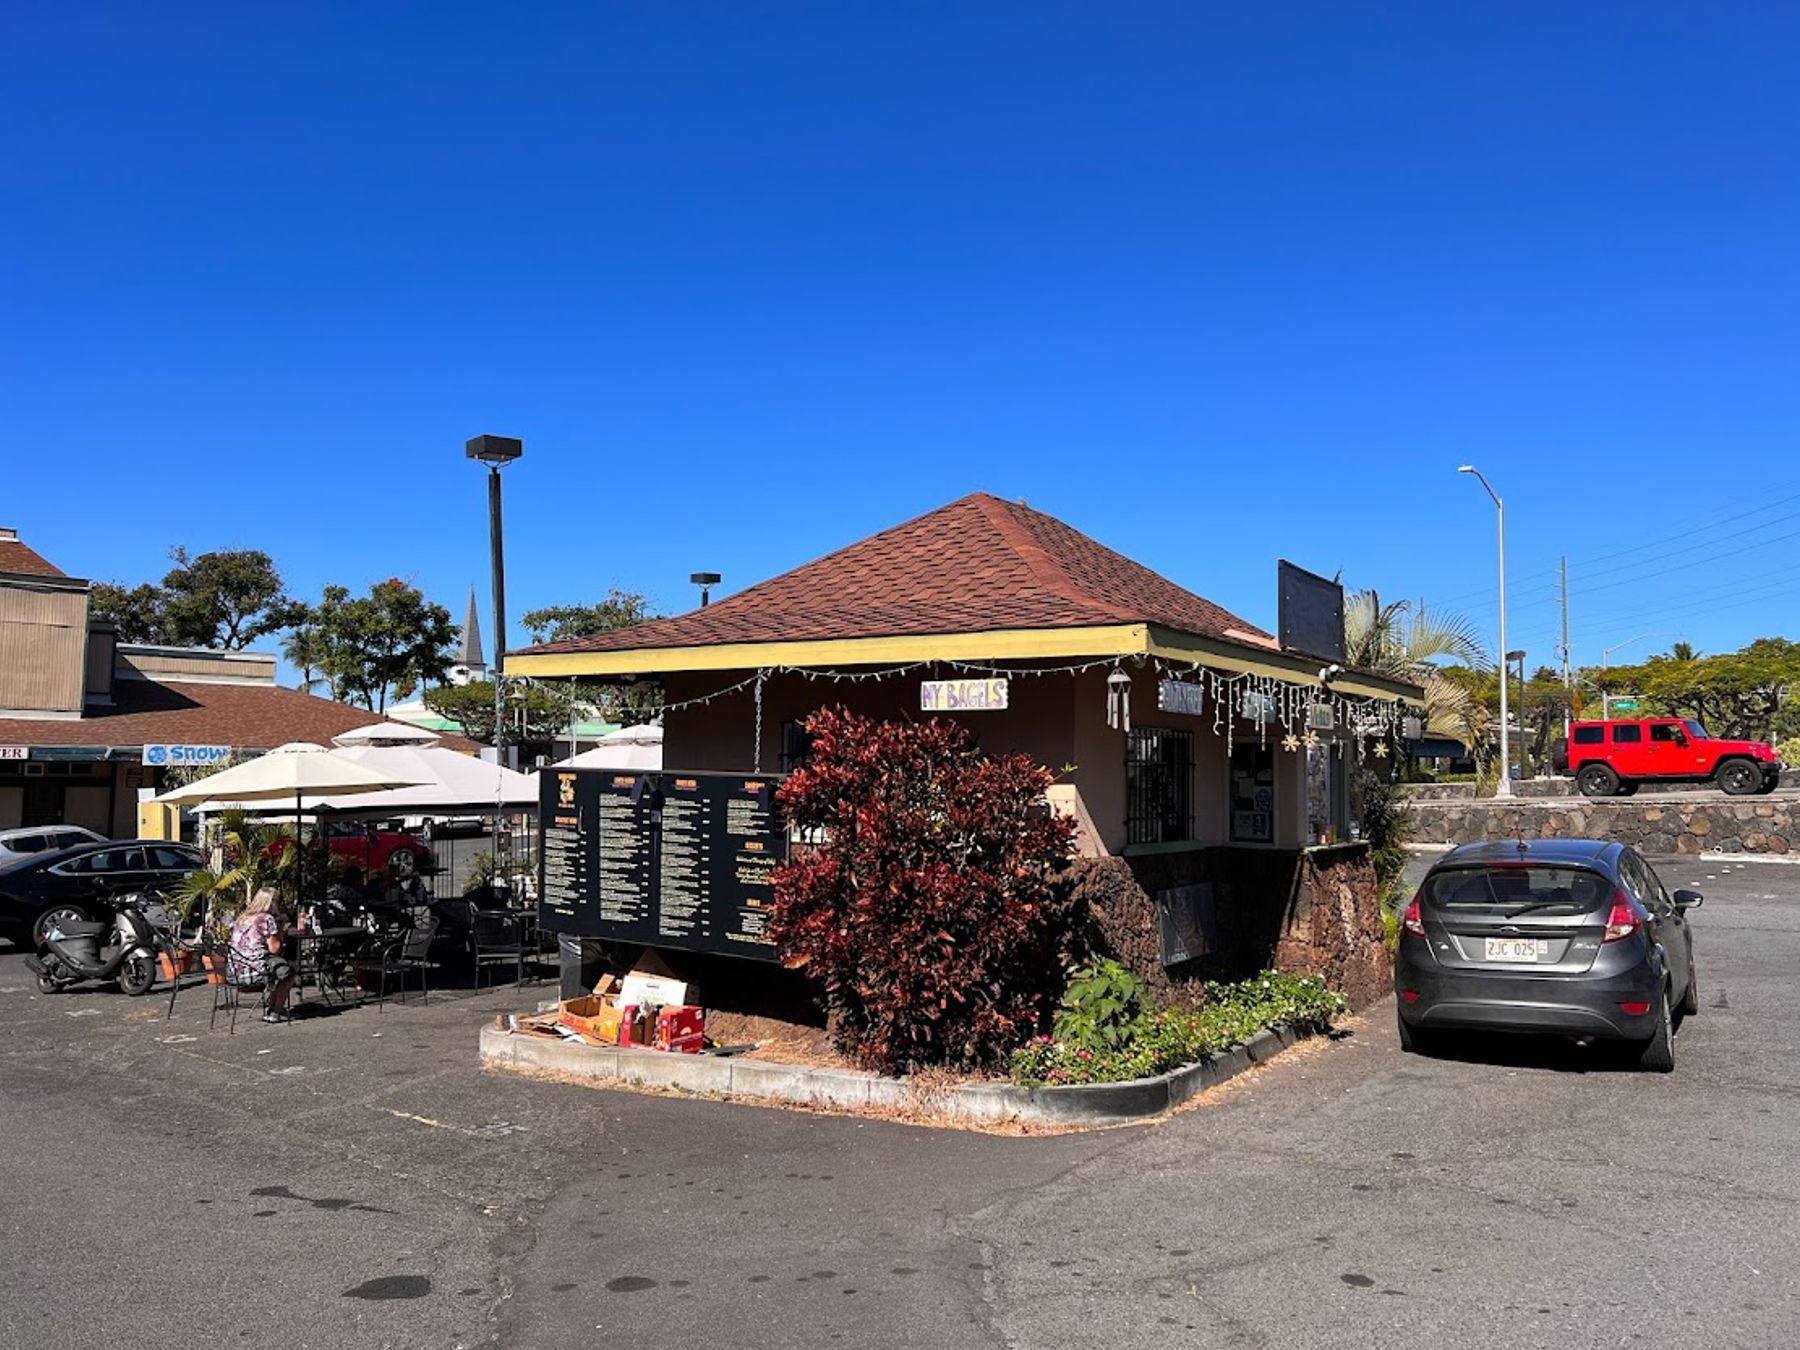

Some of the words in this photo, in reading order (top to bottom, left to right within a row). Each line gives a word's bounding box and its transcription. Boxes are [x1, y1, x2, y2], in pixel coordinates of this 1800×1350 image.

[0, 748, 22, 758] ER
[1487, 941, 1509, 956] ZJC
[1514, 942, 1535, 956] 025
